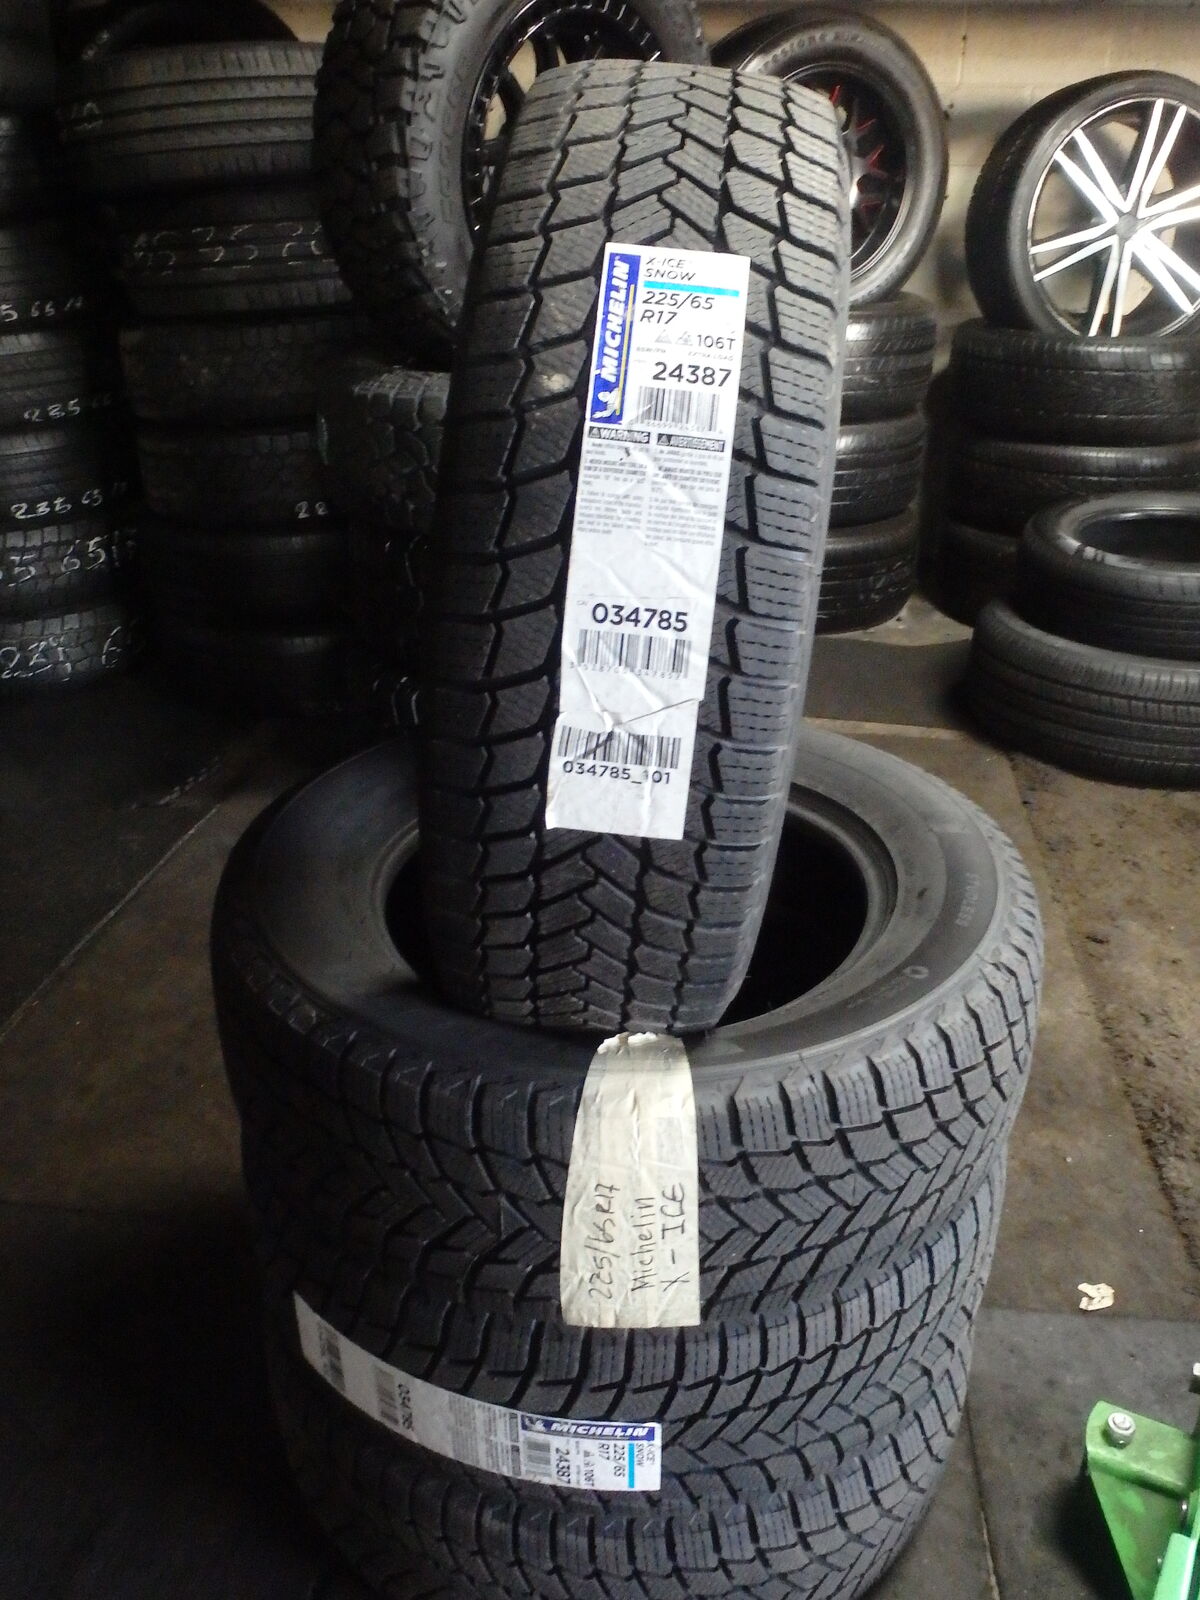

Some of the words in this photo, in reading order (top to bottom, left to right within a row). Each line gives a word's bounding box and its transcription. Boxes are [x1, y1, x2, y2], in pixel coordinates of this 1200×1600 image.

[643, 268, 696, 281] SNOW
[642, 291, 715, 310] 225/65
[600, 260, 630, 383] MICHELIN
[640, 309, 678, 325] R17
[697, 334, 736, 350] 106T
[652, 361, 732, 387] 24387
[600, 429, 649, 444] WARNING
[592, 603, 688, 632] 034785
[630, 1197, 658, 1292] Michelin
[551, 1421, 649, 1438] MICHELIN
[598, 1442, 610, 1461] R17
[613, 1442, 626, 1477] 225/65
[556, 1446, 571, 1485] 24387
